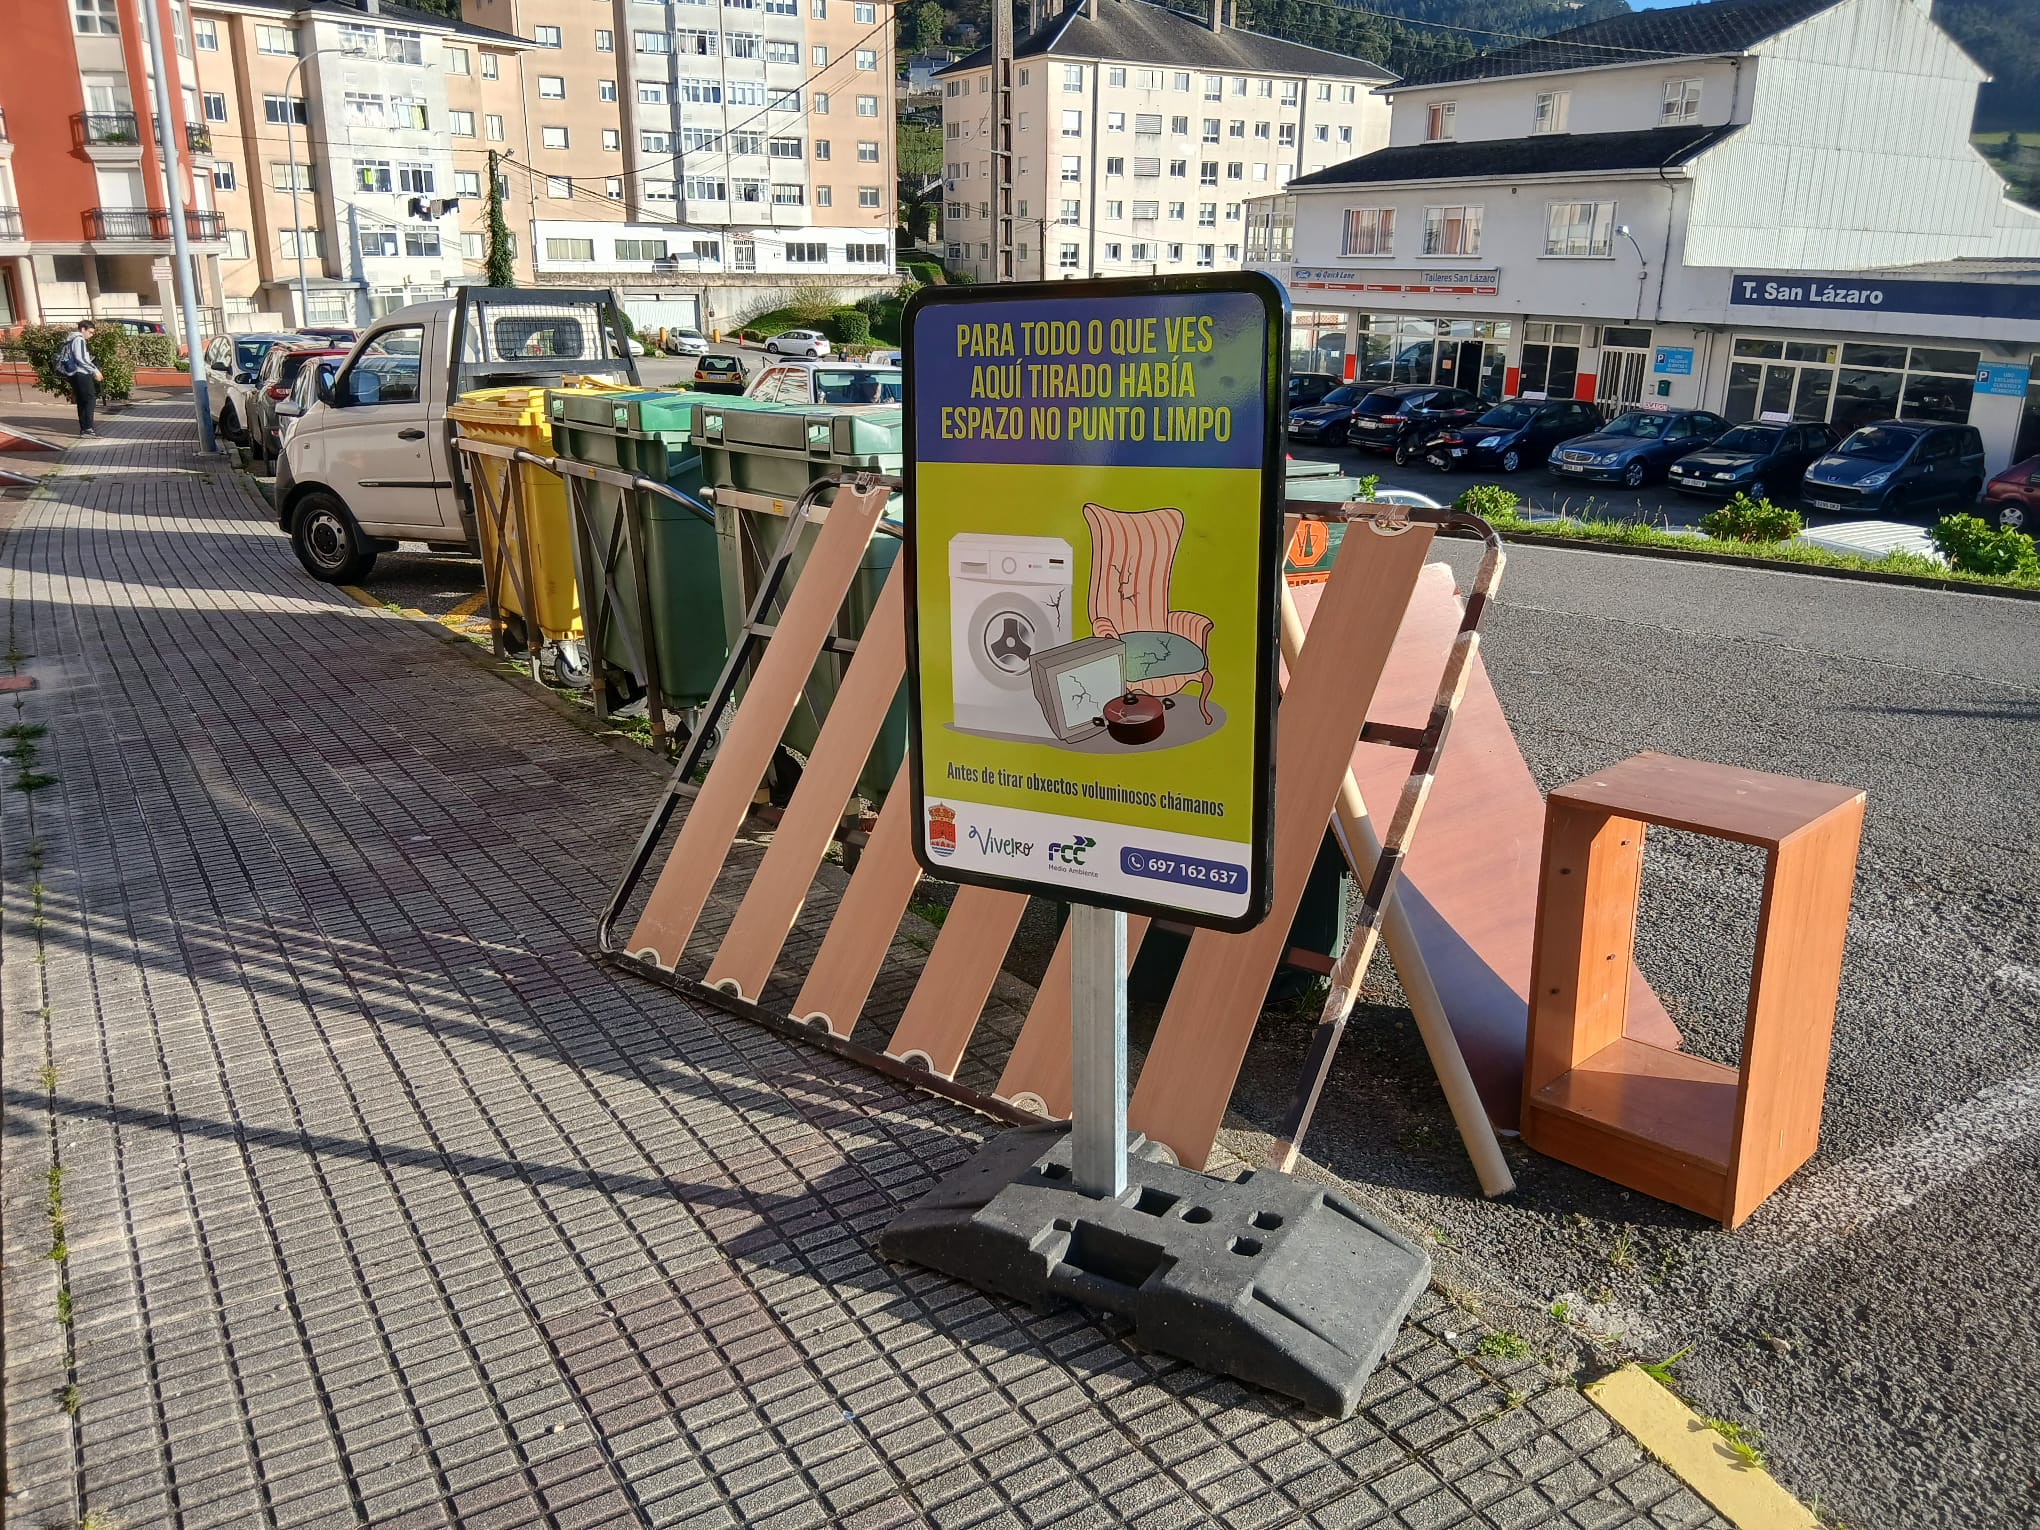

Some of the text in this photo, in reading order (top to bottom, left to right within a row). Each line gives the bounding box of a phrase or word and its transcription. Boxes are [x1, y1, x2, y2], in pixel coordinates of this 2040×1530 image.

[1424, 273, 1496, 283] Talleres San Lázaro
[1742, 281, 1884, 304] T. San Lázaro
[957, 316, 1214, 357] PARA TODO O QUE VES
[970, 356, 1196, 400] AQUÍ TIRADO HABÍA
[941, 406, 1232, 442] ESPAZO NO PUNTO LIMPO
[947, 761, 1224, 817] Antes de tirar obxectos voluminosos chámanos
[1048, 864, 1099, 878] Medio Ambiente
[1148, 858, 1238, 884] 697 162 637
